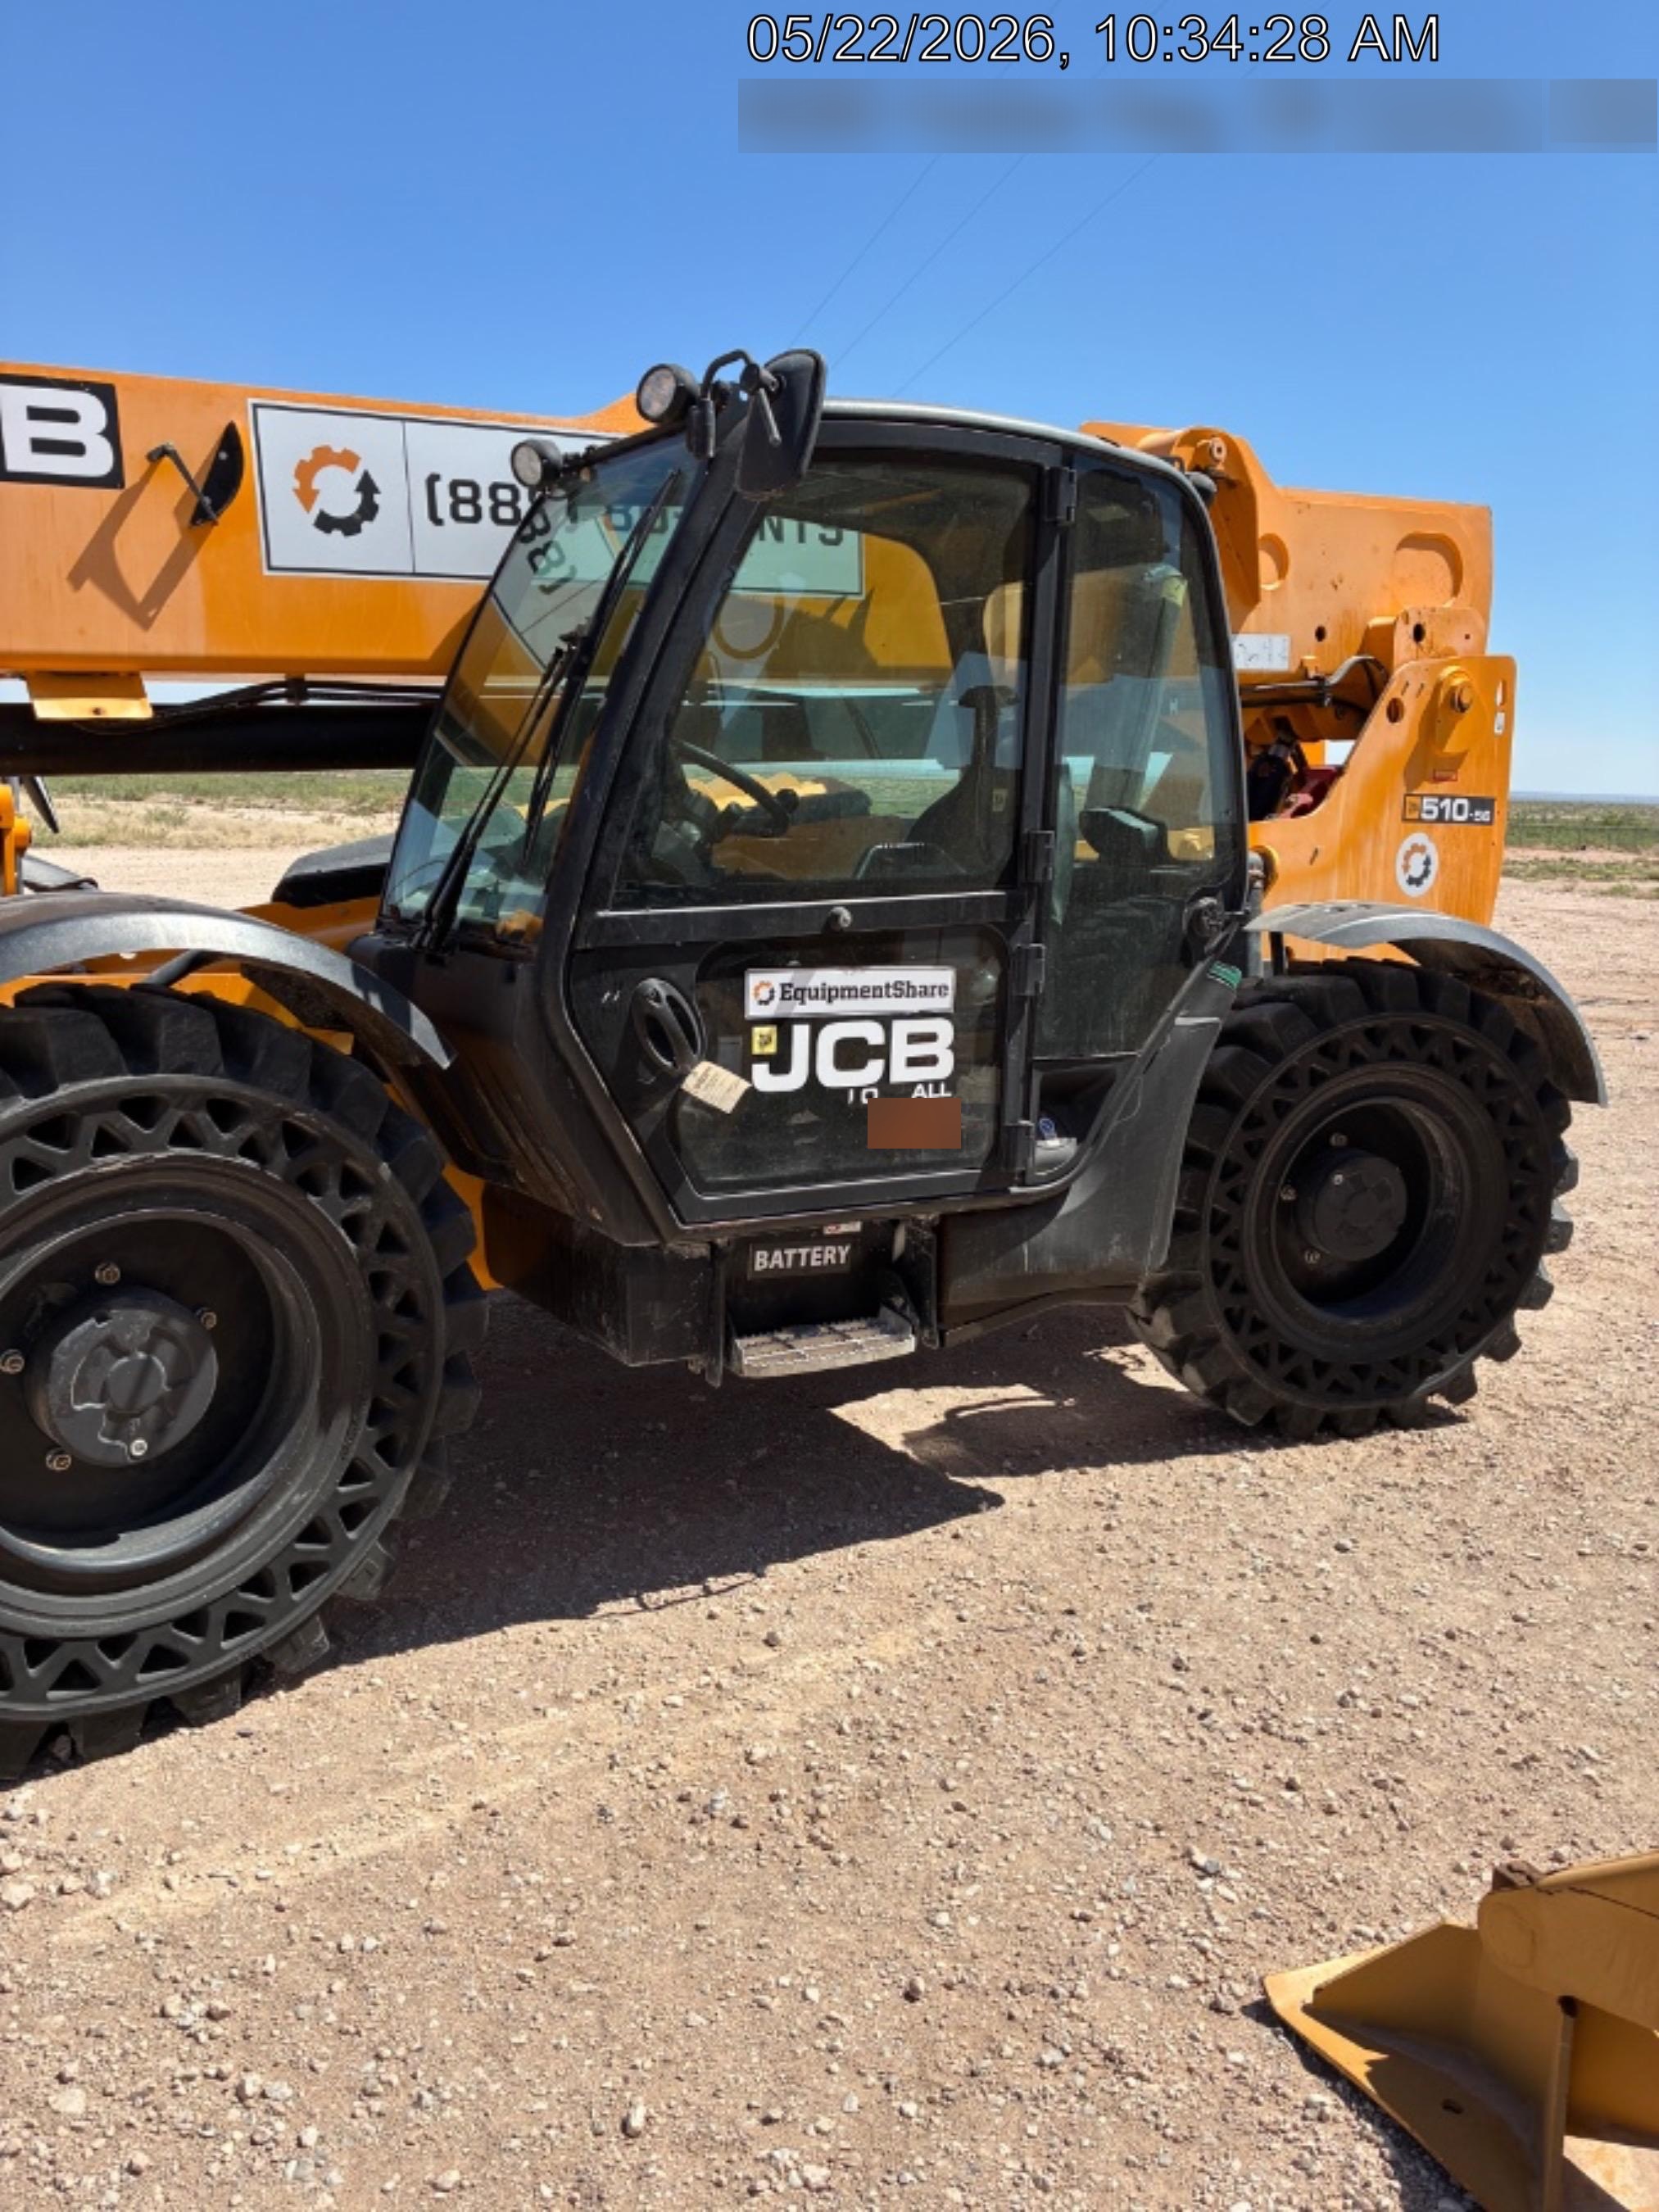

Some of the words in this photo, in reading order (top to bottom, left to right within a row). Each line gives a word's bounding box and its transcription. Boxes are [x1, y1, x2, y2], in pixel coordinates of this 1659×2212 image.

[779, 980, 950, 1004] EquipmentShare
[751, 1018, 955, 1093] JCB
[754, 1244, 851, 1271] BATTERY
